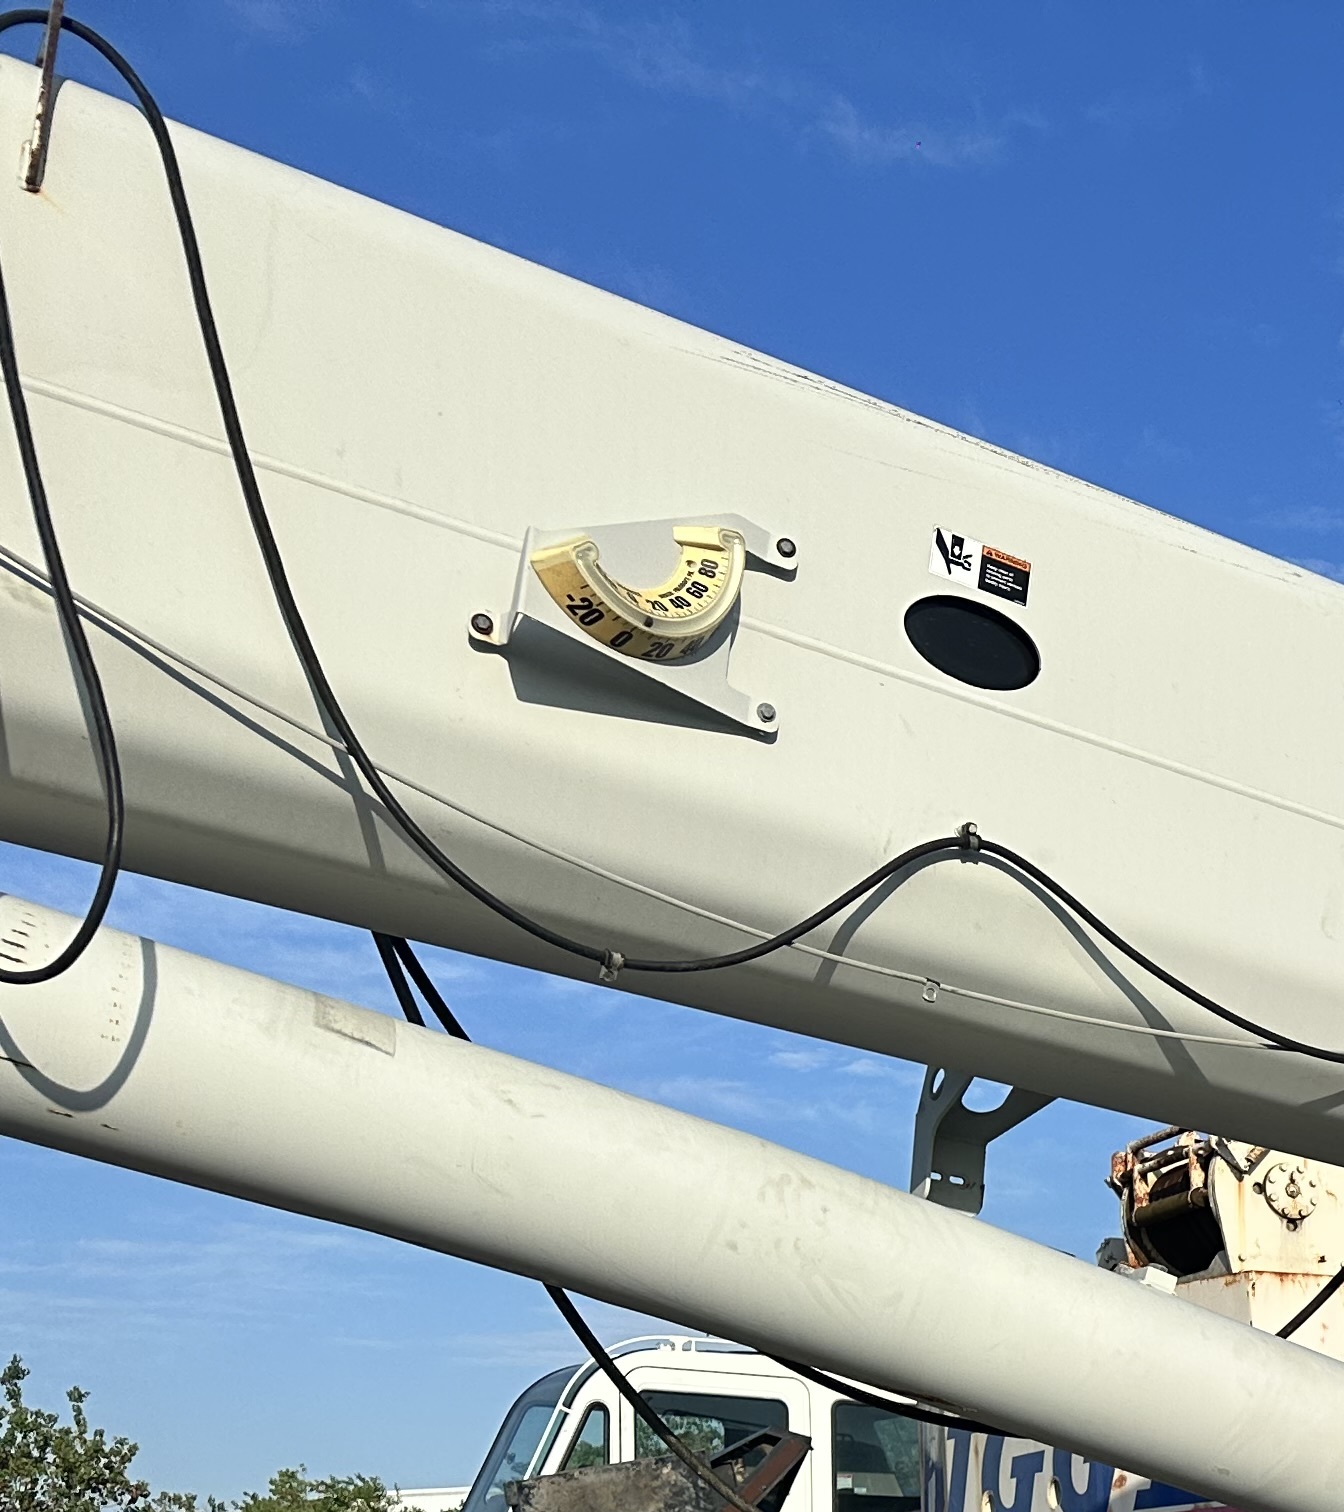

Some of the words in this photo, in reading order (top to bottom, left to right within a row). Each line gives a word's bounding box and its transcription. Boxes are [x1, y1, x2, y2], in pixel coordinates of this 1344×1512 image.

[698, 558, 719, 579] 80
[994, 551, 1028, 570] WARNING
[686, 580, 709, 600] 60
[566, 593, 605, 627] -20
[645, 599, 669, 612] 20
[669, 595, 692, 610] 40
[609, 630, 634, 648] 0
[641, 641, 675, 659] 20
